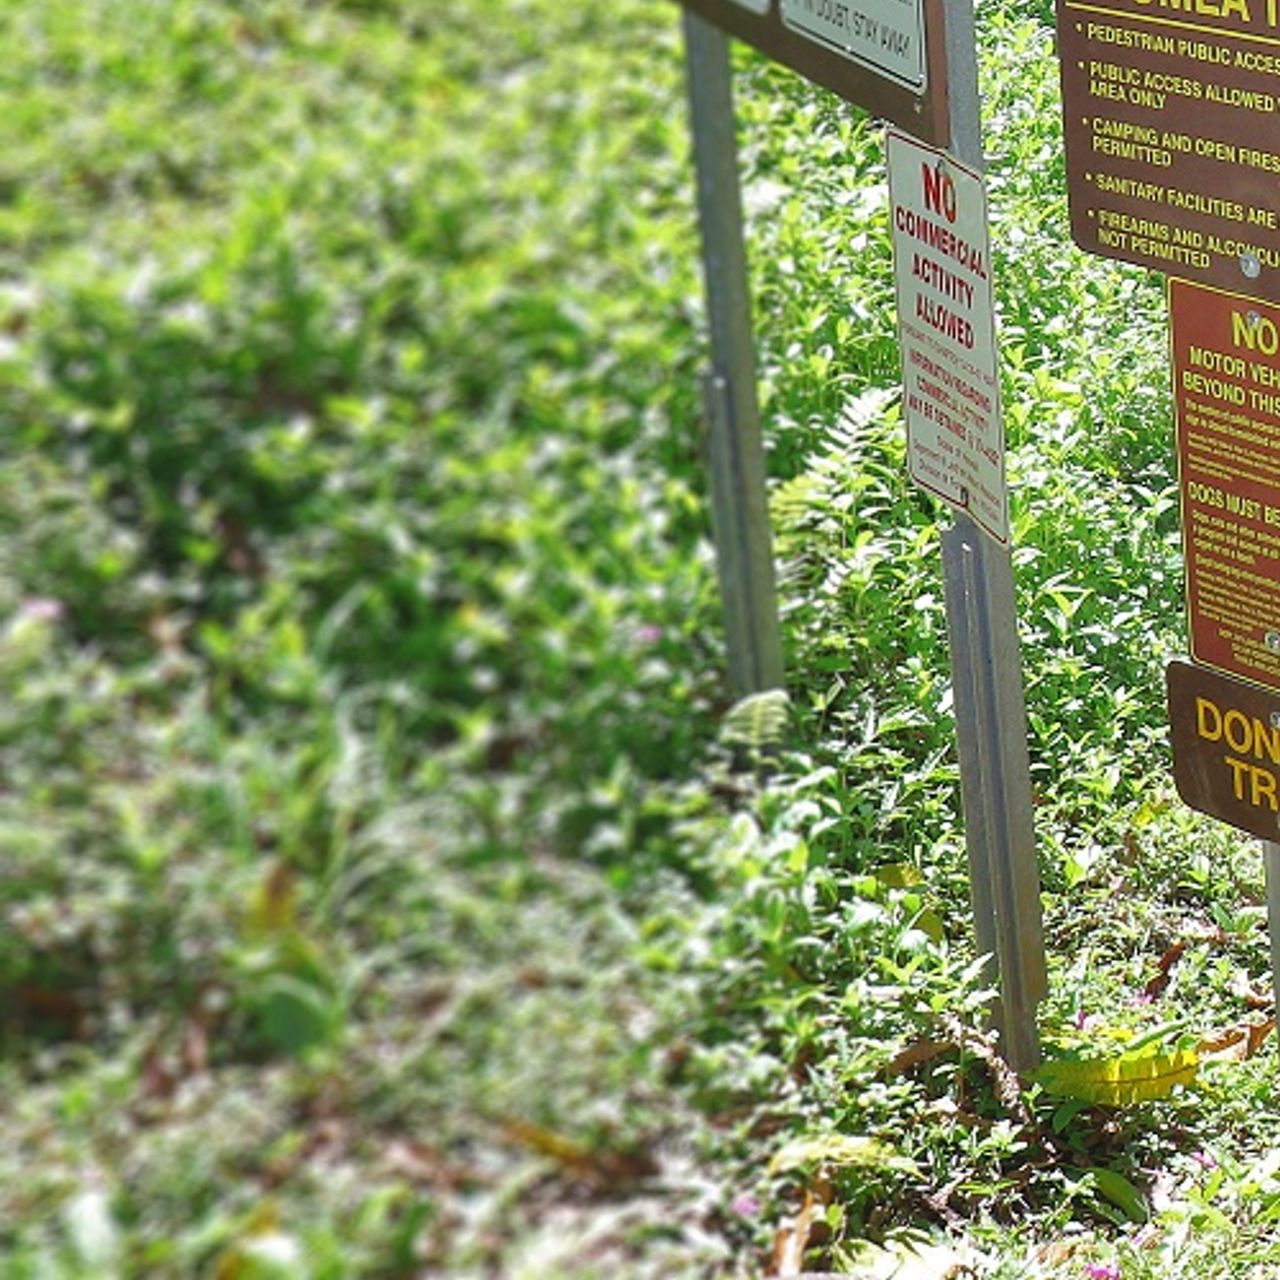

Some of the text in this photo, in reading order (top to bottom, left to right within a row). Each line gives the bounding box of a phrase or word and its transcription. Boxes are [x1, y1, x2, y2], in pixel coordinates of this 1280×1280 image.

[1088, 23, 1174, 54] PEDESTRIAN
[1178, 40, 1230, 64] PUBLIC
[1090, 61, 1141, 85] PUBLIC
[1144, 73, 1202, 98] ACCESS
[1206, 84, 1274, 111] ALLOWED
[1090, 81, 1166, 108] AREA ONLY
[1092, 117, 1158, 144] CAMPING
[1162, 132, 1192, 152] AND
[1195, 138, 1236, 162] OPEN
[1239, 148, 1280, 172] FIRES
[1092, 136, 1172, 166] PERMITTED
[921, 161, 956, 223] NO
[1096, 174, 1164, 201] SANITARY
[1167, 189, 1243, 221] FACILITIES
[1248, 207, 1276, 229] ARE
[896, 205, 986, 280] COMMERCIAL
[1098, 228, 1210, 268] NOT PERMITTED
[1099, 209, 1169, 242] FIREARMS
[1173, 228, 1202, 248] AND
[912, 252, 974, 310] ACTIVITY
[916, 292, 974, 350] ALLOWED
[1231, 311, 1279, 355] NO
[1190, 345, 1246, 379] MOTOR
[1183, 371, 1245, 405] BEYOND
[1188, 481, 1224, 509] DOGS
[1226, 493, 1261, 519] MUST
